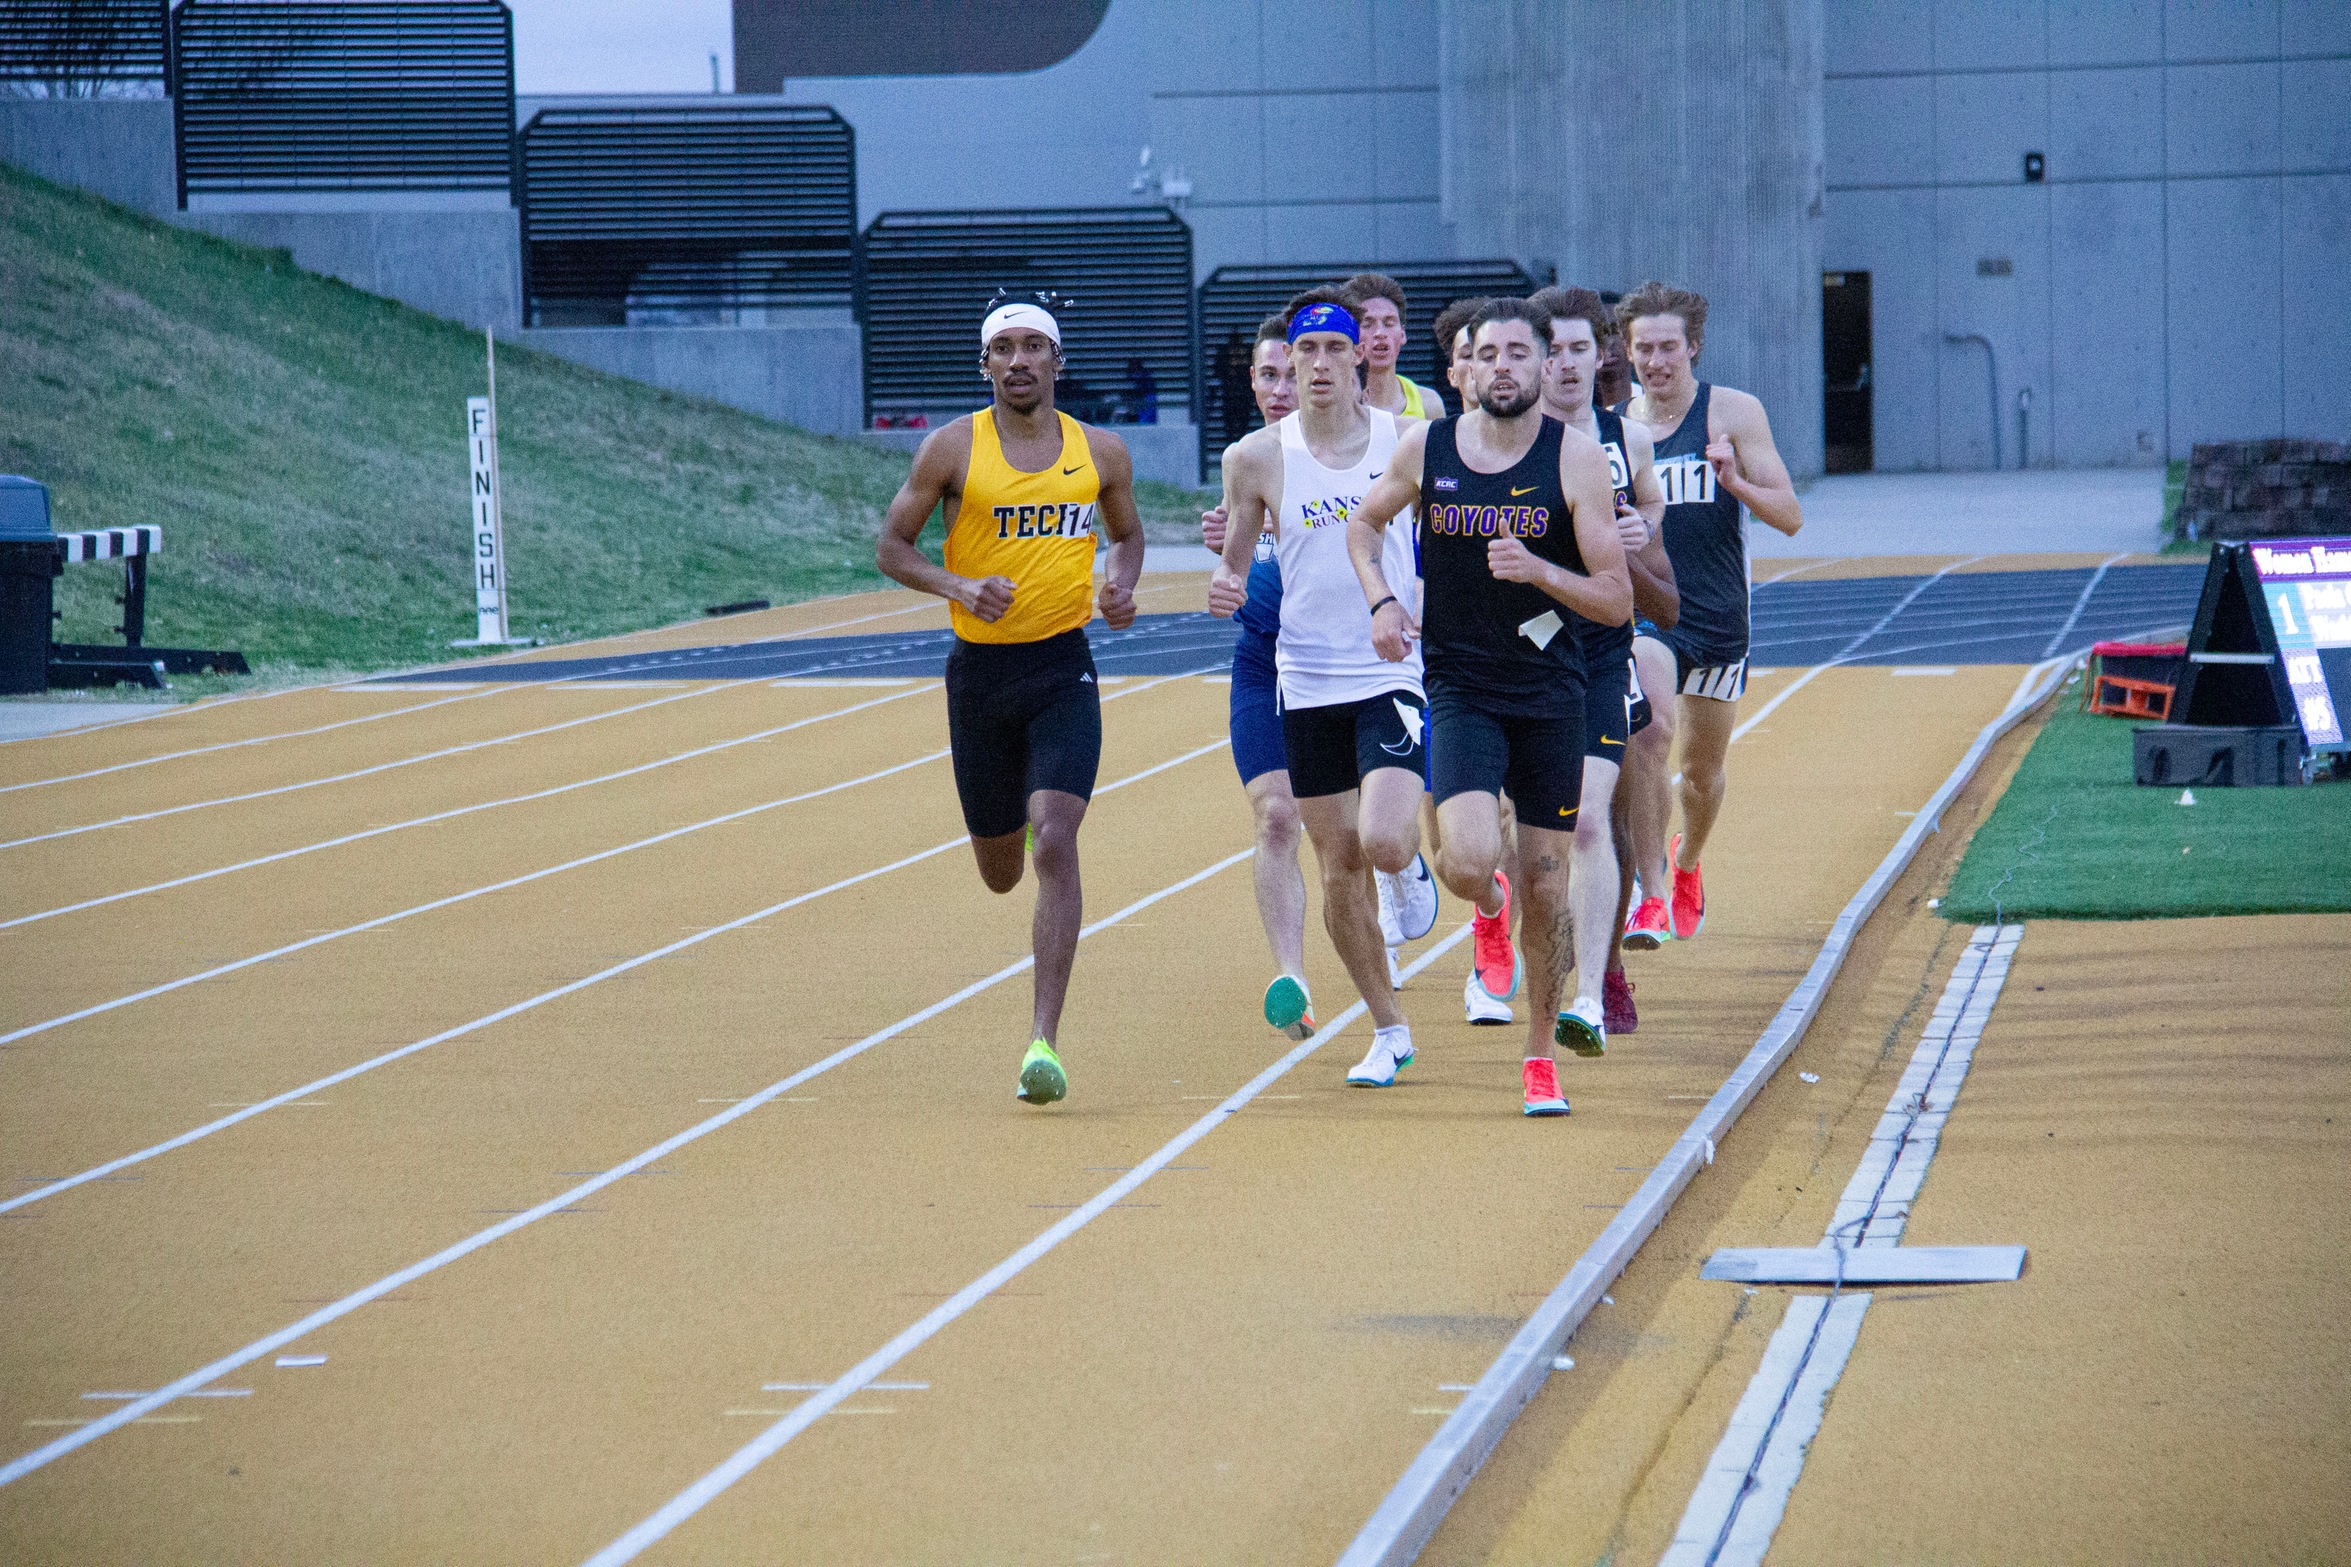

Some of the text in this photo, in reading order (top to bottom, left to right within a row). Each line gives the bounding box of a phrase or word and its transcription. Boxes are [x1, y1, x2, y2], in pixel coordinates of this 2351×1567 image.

[472, 409, 495, 589] FINISH
[1660, 464, 1706, 502] 11
[1069, 505, 1094, 536] 14
[1302, 496, 1362, 519] KANS
[1429, 503, 1549, 538] COYOTES
[2278, 593, 2299, 635] 1
[1697, 666, 1741, 699] 11
